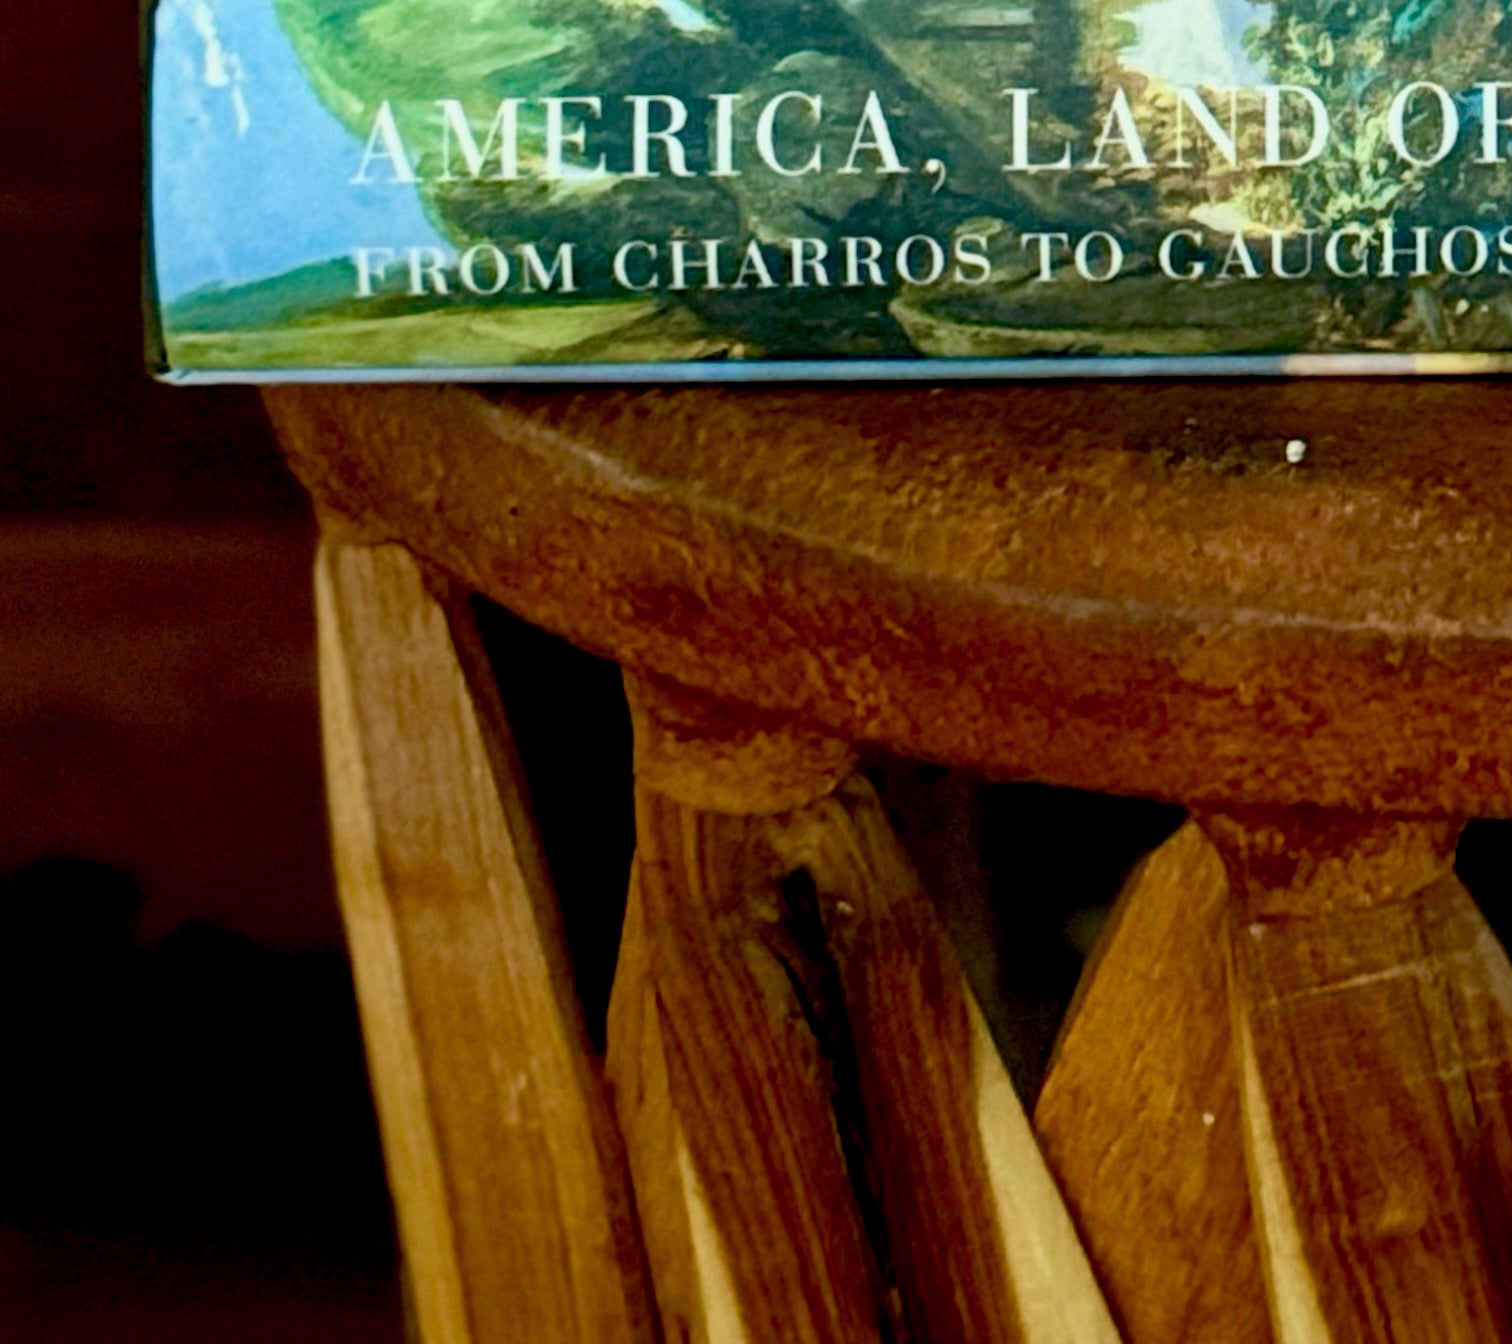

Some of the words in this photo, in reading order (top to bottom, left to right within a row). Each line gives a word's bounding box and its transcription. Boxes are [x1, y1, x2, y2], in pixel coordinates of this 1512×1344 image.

[348, 87, 950, 194] AMERICA,
[1002, 82, 1331, 175] LAND
[352, 240, 578, 298] FROM
[612, 234, 995, 292] CHARROS
[1020, 230, 1125, 283] TO
